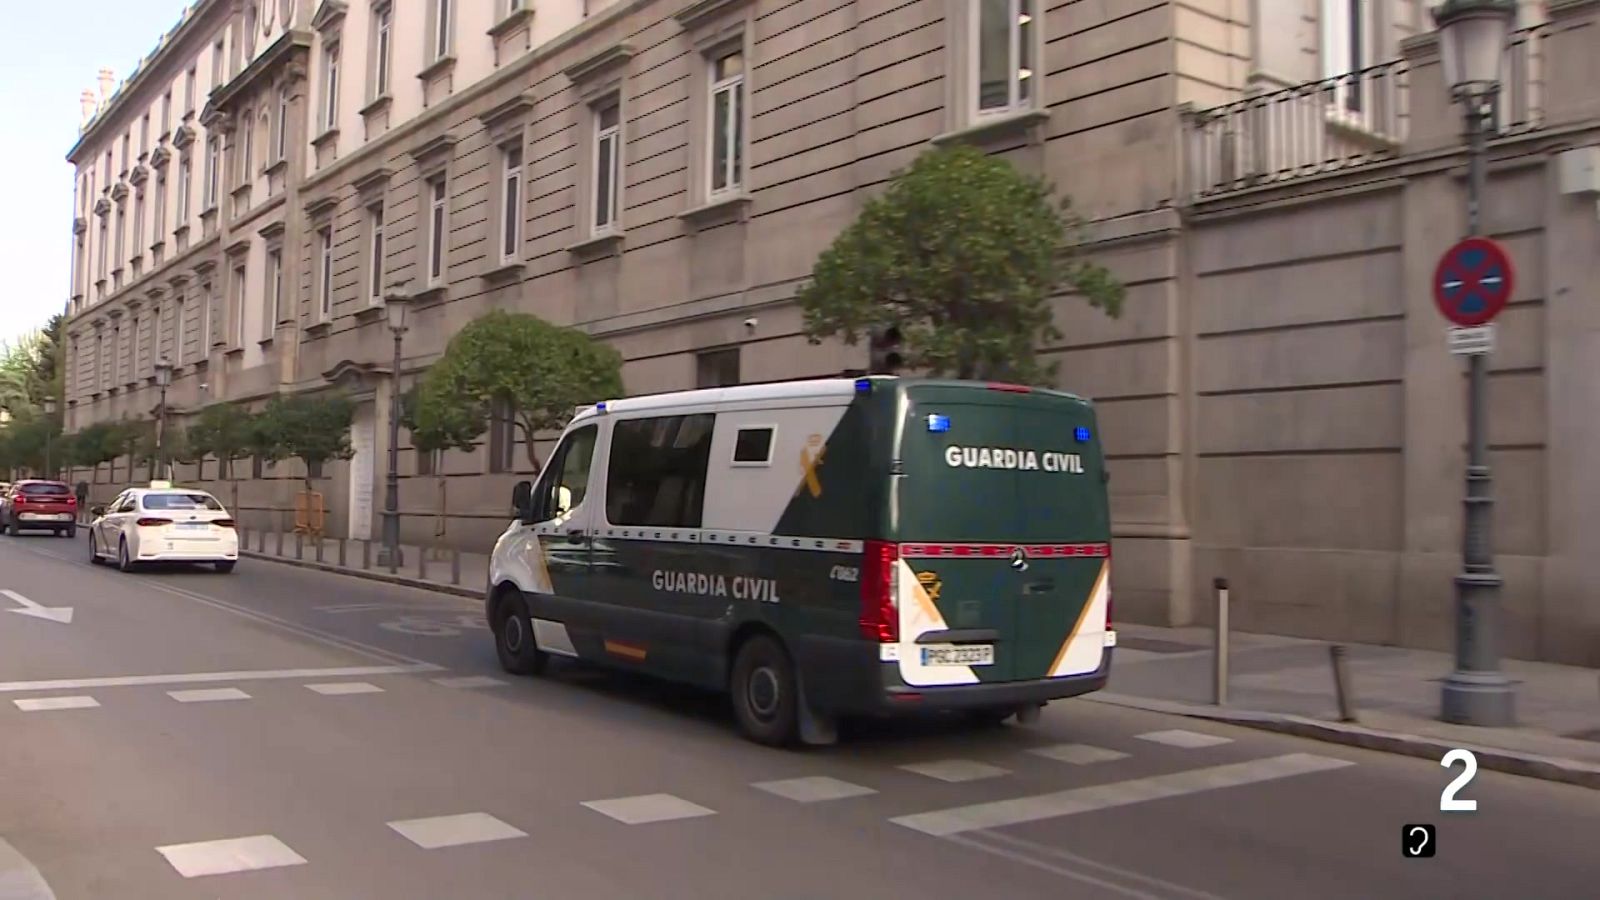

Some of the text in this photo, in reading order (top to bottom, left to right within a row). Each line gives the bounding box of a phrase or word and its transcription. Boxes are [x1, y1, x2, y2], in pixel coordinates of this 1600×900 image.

[944, 445, 1085, 474] GUARDIA CIVIL
[652, 569, 781, 603] GUARDIA CIVIL
